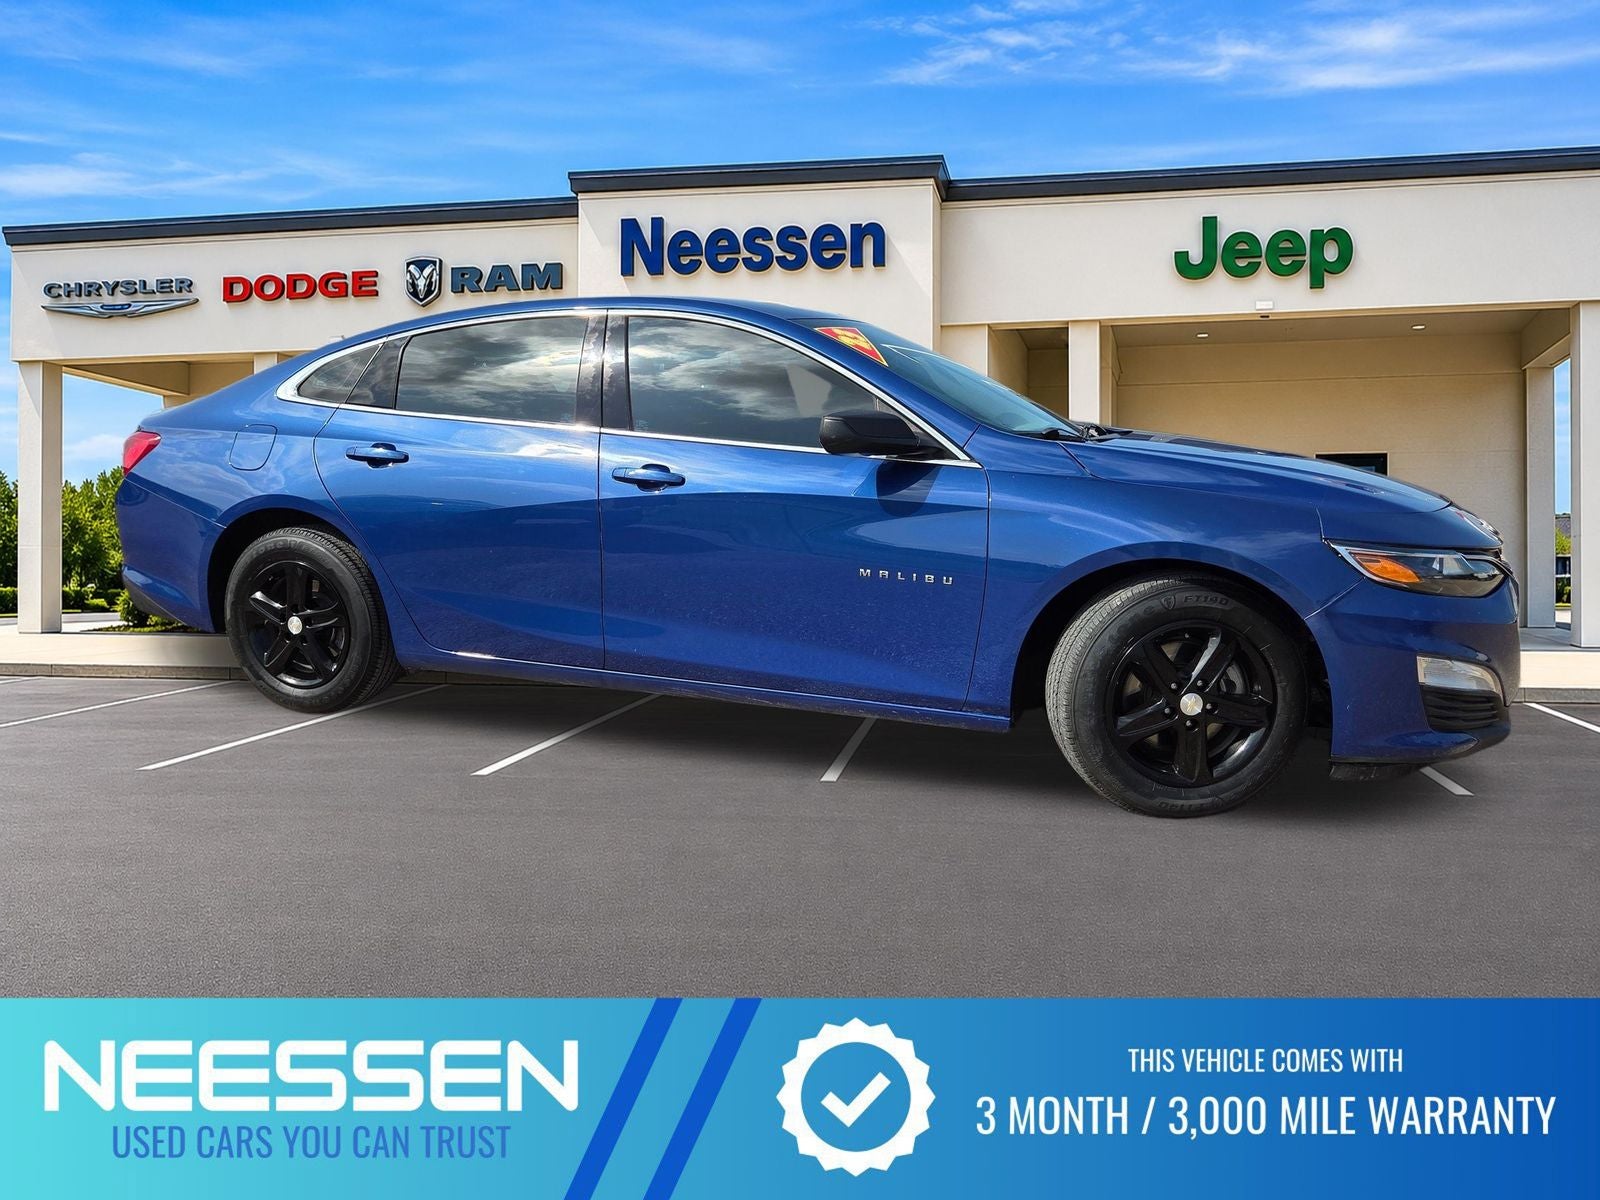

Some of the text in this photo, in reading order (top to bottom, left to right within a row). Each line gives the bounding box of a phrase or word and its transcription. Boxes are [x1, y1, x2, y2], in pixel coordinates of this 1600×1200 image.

[620, 217, 886, 276] Neessen
[1173, 215, 1354, 289] Jeep
[43, 277, 194, 299] CHRYSLER
[222, 270, 379, 302] DODGE
[450, 262, 564, 294] RAM
[859, 568, 953, 585] MALIBU
